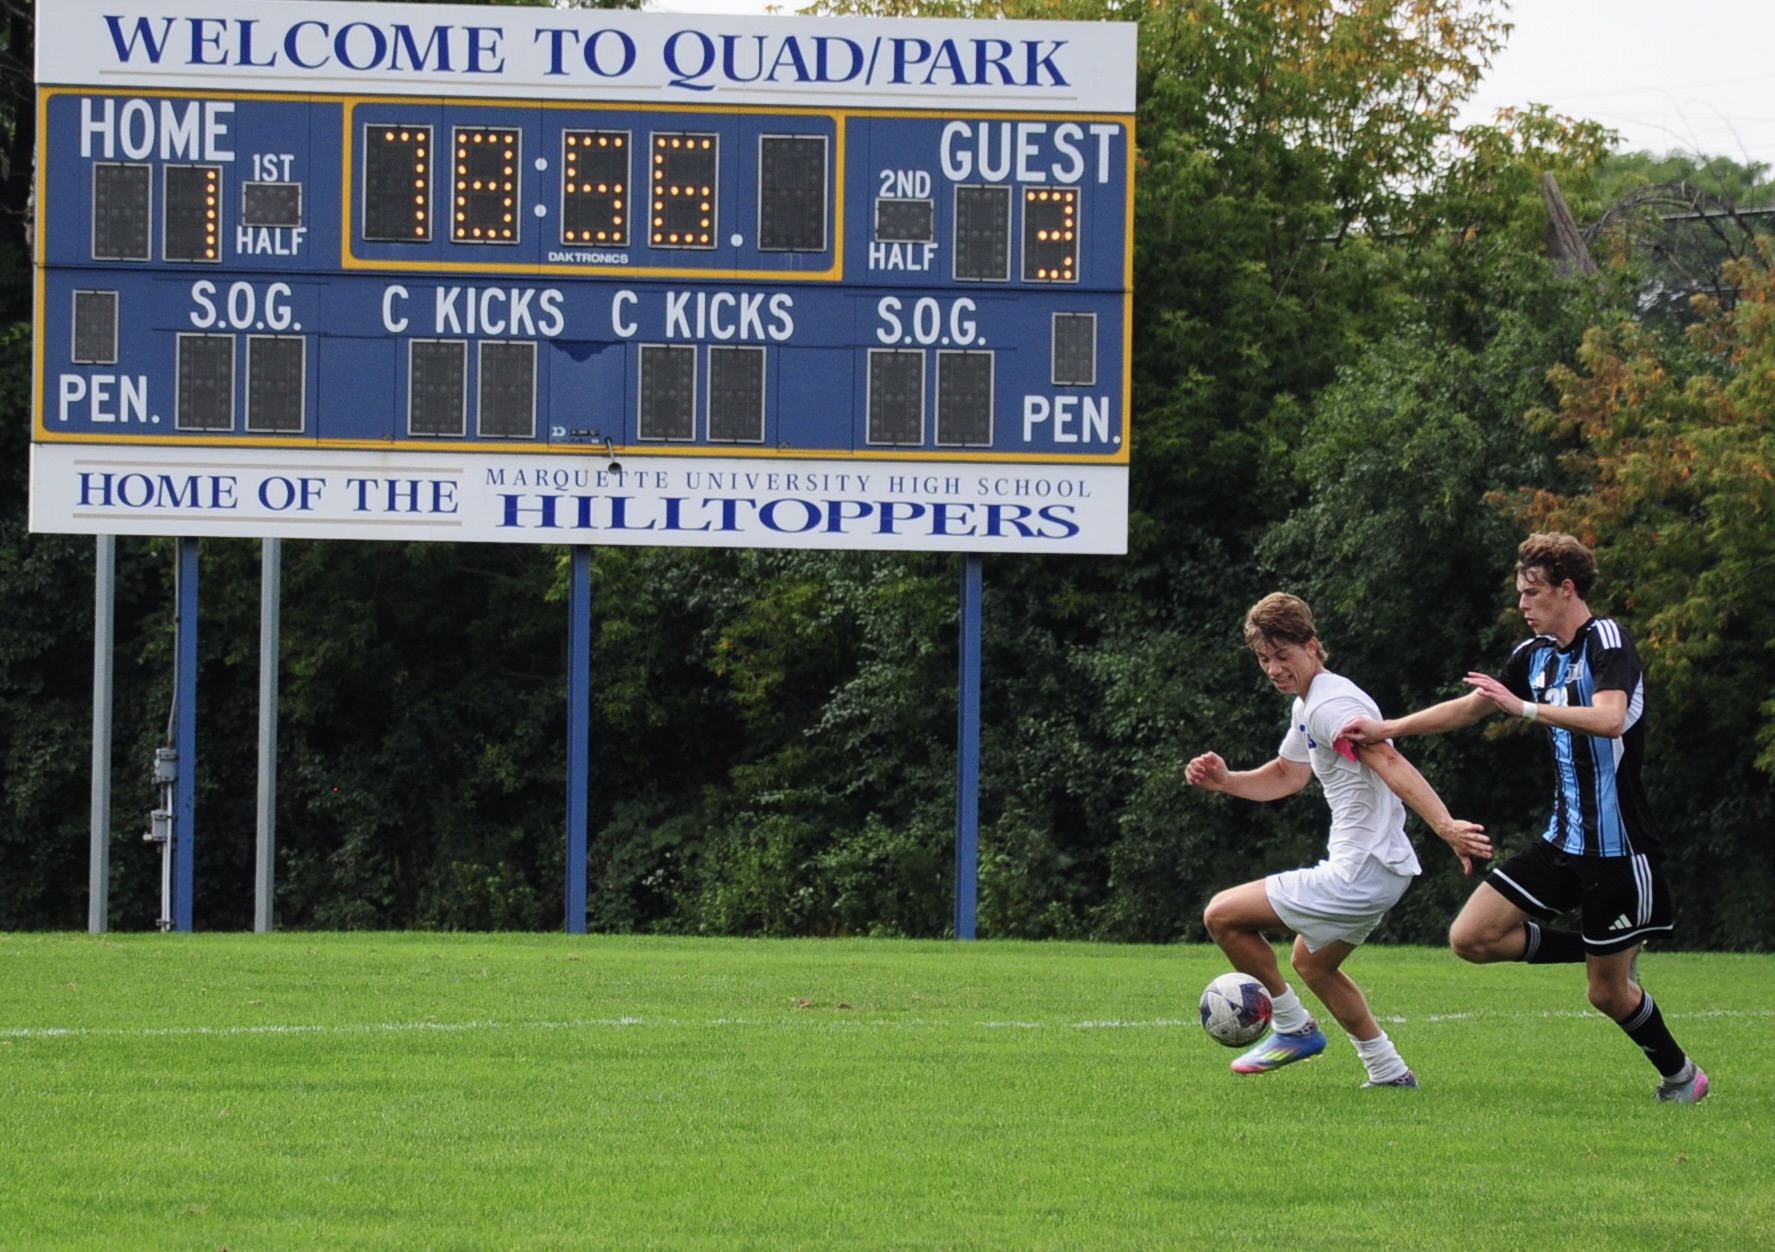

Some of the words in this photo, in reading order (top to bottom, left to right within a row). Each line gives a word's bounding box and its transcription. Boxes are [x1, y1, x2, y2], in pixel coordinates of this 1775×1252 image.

[103, 15, 506, 74] WELCOME
[534, 27, 638, 77] TO
[662, 30, 1072, 92] QUAD/PARK
[80, 98, 236, 162] HOME
[940, 120, 1121, 185] GUEST
[253, 154, 295, 182] 1ST
[879, 170, 931, 198] 2ND
[236, 227, 307, 256] HALF
[548, 251, 630, 264] DAKTRONICS
[868, 242, 939, 271] HALF
[190, 280, 302, 331] S.O.G.
[382, 285, 409, 333] C
[435, 286, 565, 337] KICKS
[611, 289, 639, 338] C
[666, 291, 794, 341] KICKS
[876, 296, 987, 346] S.O.G.
[59, 374, 160, 424] PEN.
[1023, 395, 1121, 444] PEN.
[76, 472, 239, 509] HOME
[257, 475, 326, 511] OF
[346, 478, 460, 515] THE
[485, 467, 669, 491] MARQUETTE
[685, 472, 872, 494] UNIVERSITY
[888, 476, 962, 496] HIGH
[977, 478, 1092, 498] SCHOOL
[495, 493, 1081, 540] HILLTOPPERS
